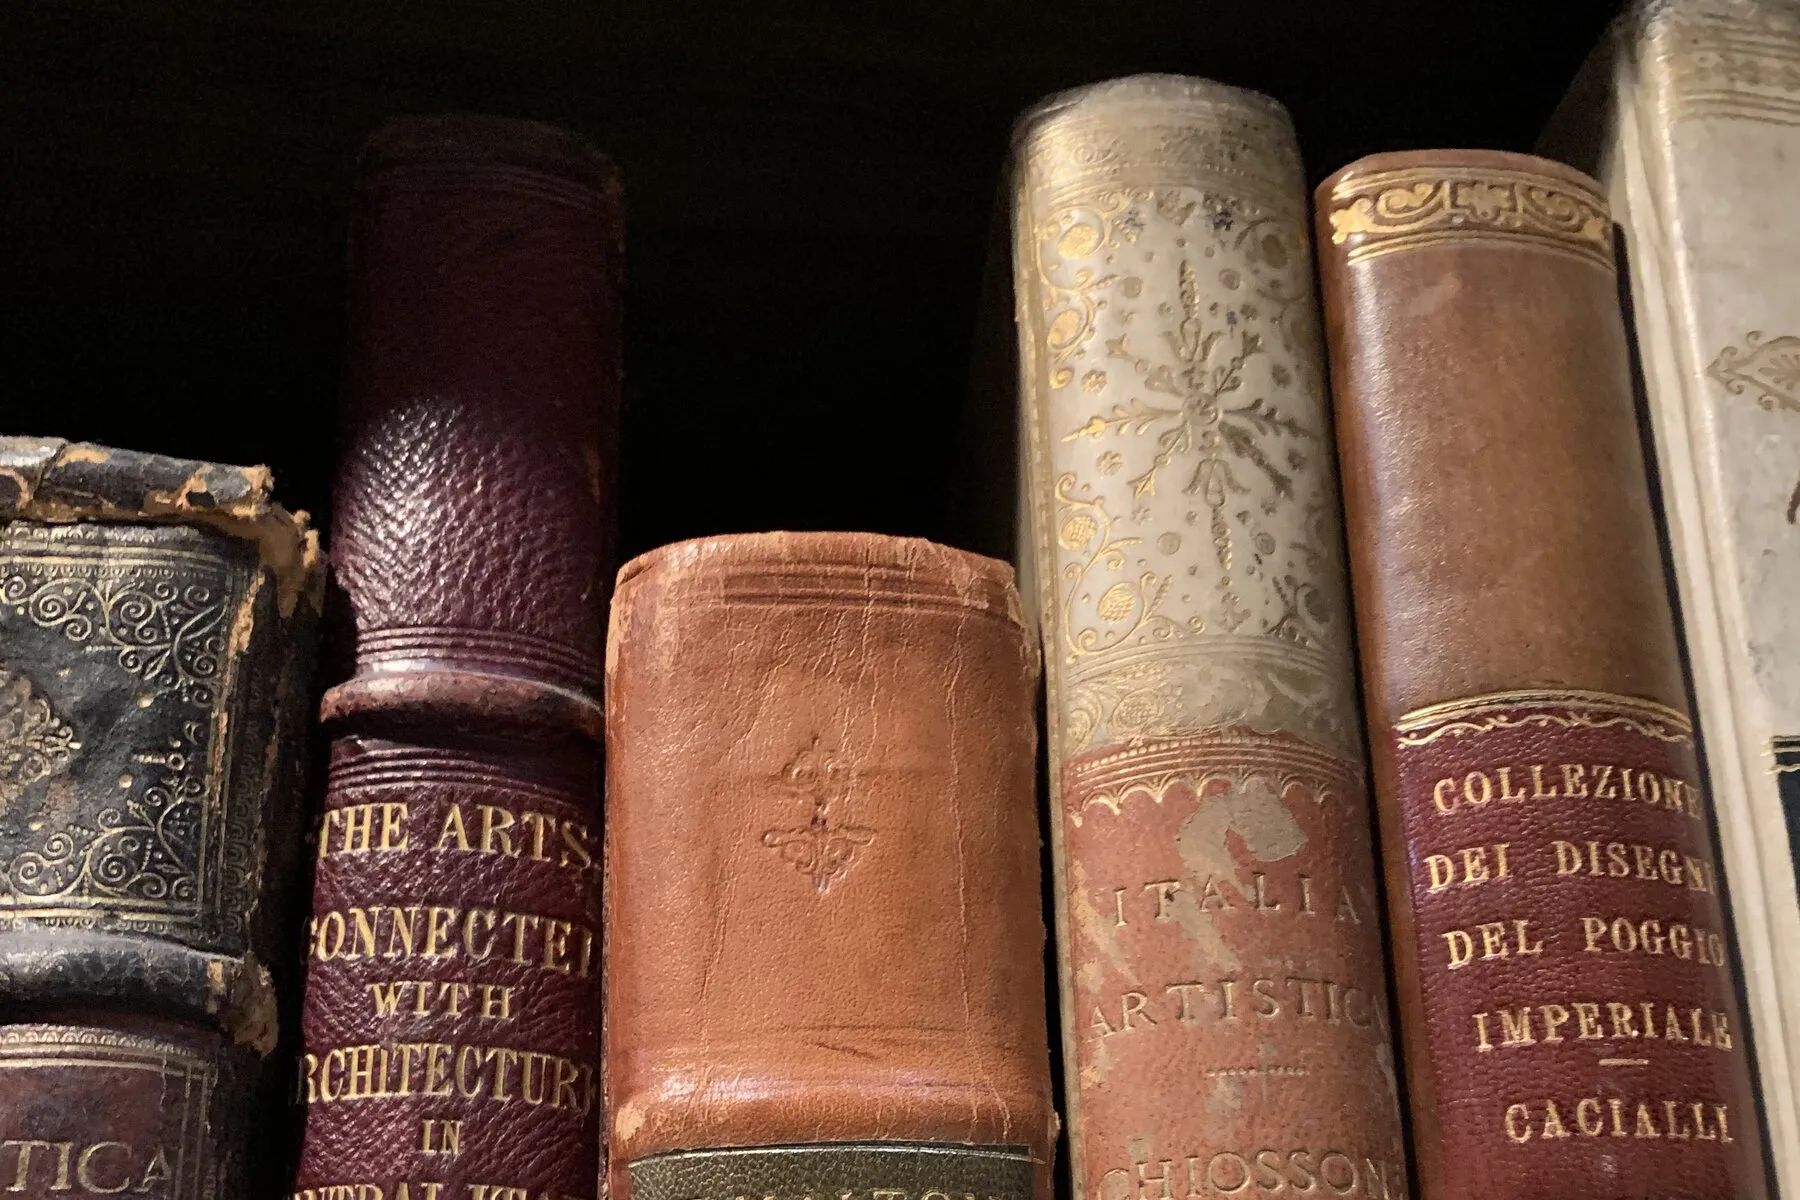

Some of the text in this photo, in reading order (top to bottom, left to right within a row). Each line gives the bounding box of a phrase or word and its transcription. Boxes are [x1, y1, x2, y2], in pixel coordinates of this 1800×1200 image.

[319, 802, 408, 860] THE
[1424, 840, 1717, 895] DEI DISEGNI
[1113, 871, 1361, 928] ITALIA
[1442, 916, 1727, 970] DEL POGGIO
[366, 981, 512, 1021] WITH
[1473, 1001, 1734, 1053] IMPERIALE
[298, 1042, 594, 1116] RCHITECTUR
[422, 1119, 464, 1156] IN
[1505, 1098, 1735, 1145] CACIALLI
